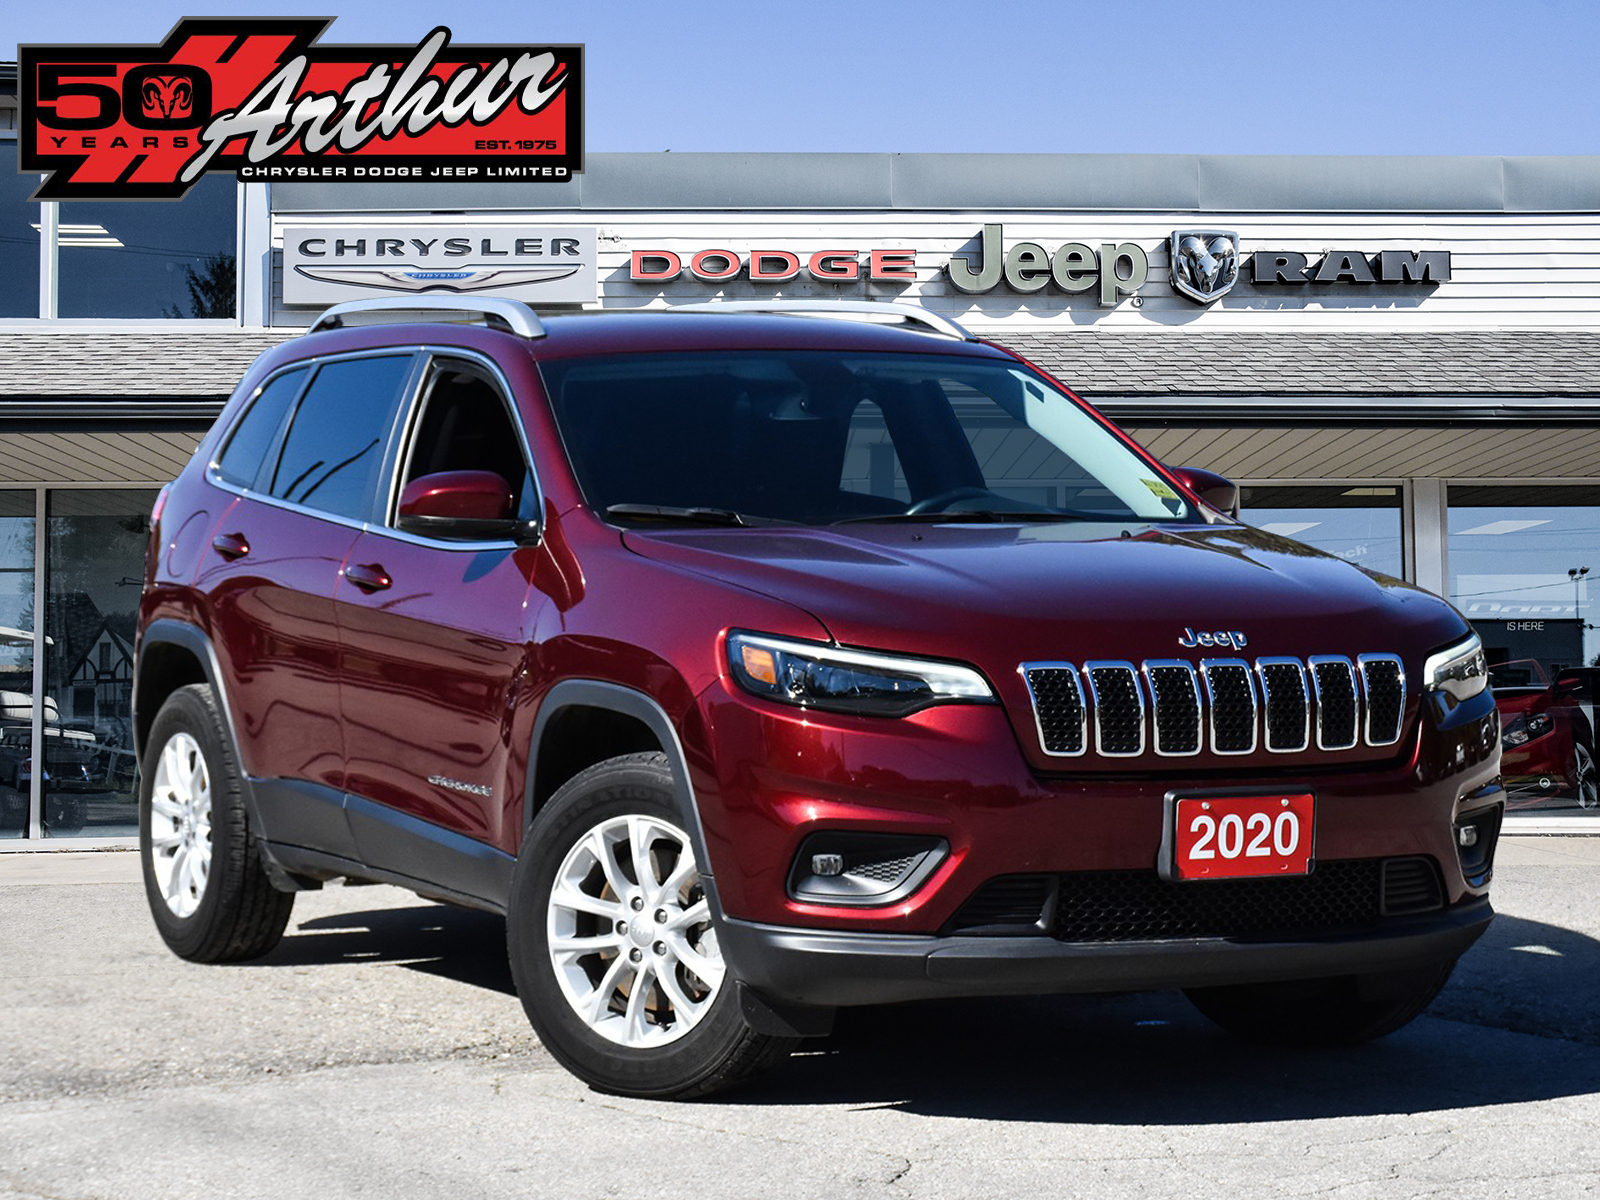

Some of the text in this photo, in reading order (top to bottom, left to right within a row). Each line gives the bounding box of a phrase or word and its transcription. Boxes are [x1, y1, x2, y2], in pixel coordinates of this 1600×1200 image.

[297, 238, 582, 257] CHRYSLER
[411, 272, 468, 280] CHRYSLER
[629, 249, 918, 284] DODGE
[948, 223, 1150, 307] Jeep
[1250, 251, 1452, 285] RAM
[1178, 627, 1249, 651] Jeep
[1506, 621, 1545, 631] IS HERE
[1188, 811, 1300, 860] 2020
